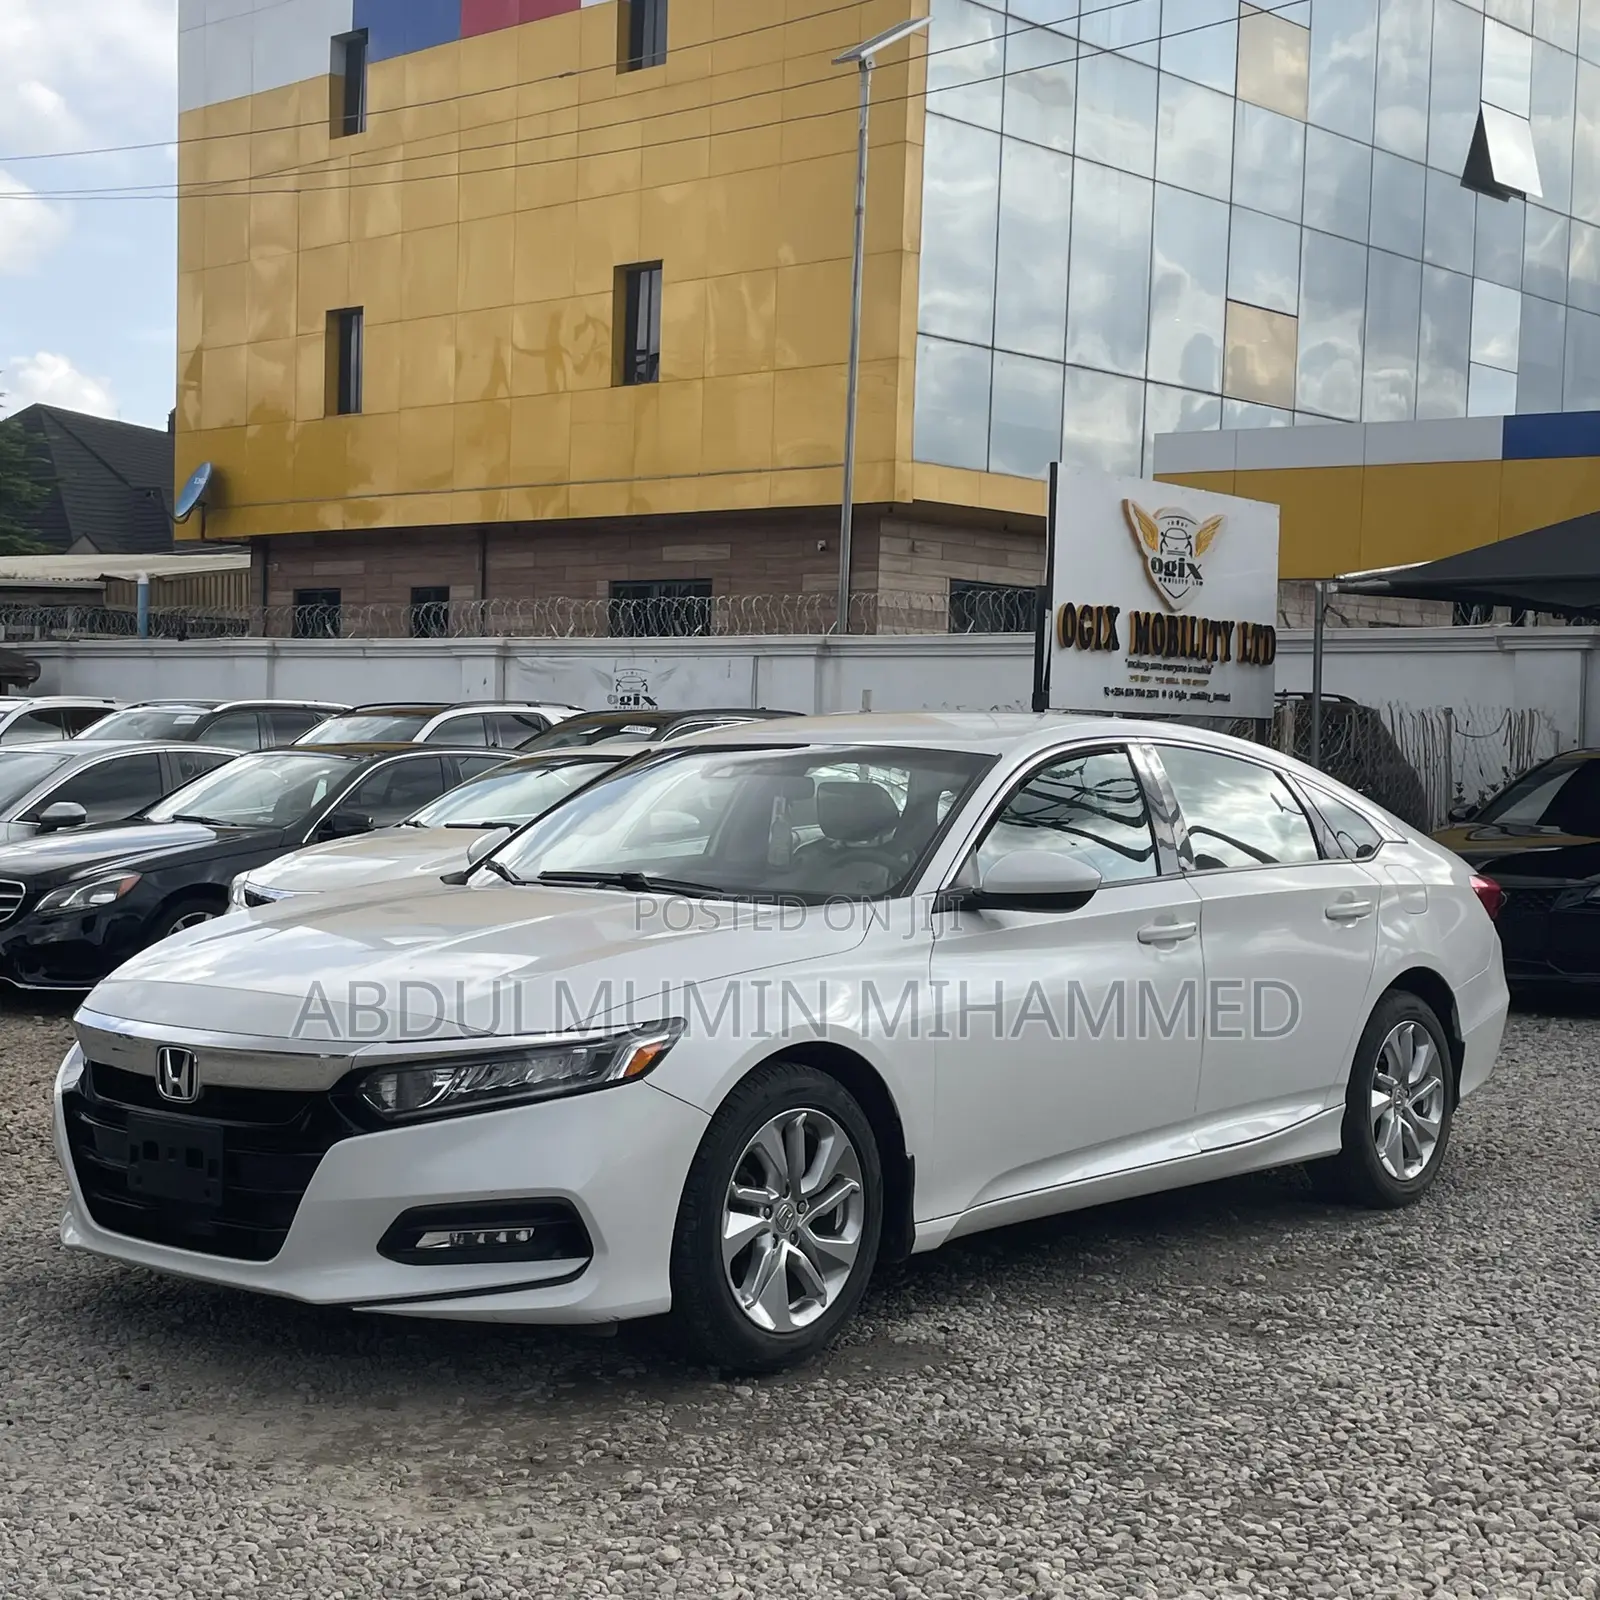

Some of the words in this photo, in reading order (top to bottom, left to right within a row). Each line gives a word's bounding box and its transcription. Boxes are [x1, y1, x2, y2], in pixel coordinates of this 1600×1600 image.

[1057, 602, 1120, 651] OGIX
[1129, 610, 1235, 664] MOBILITY
[1236, 621, 1277, 665] LTD
